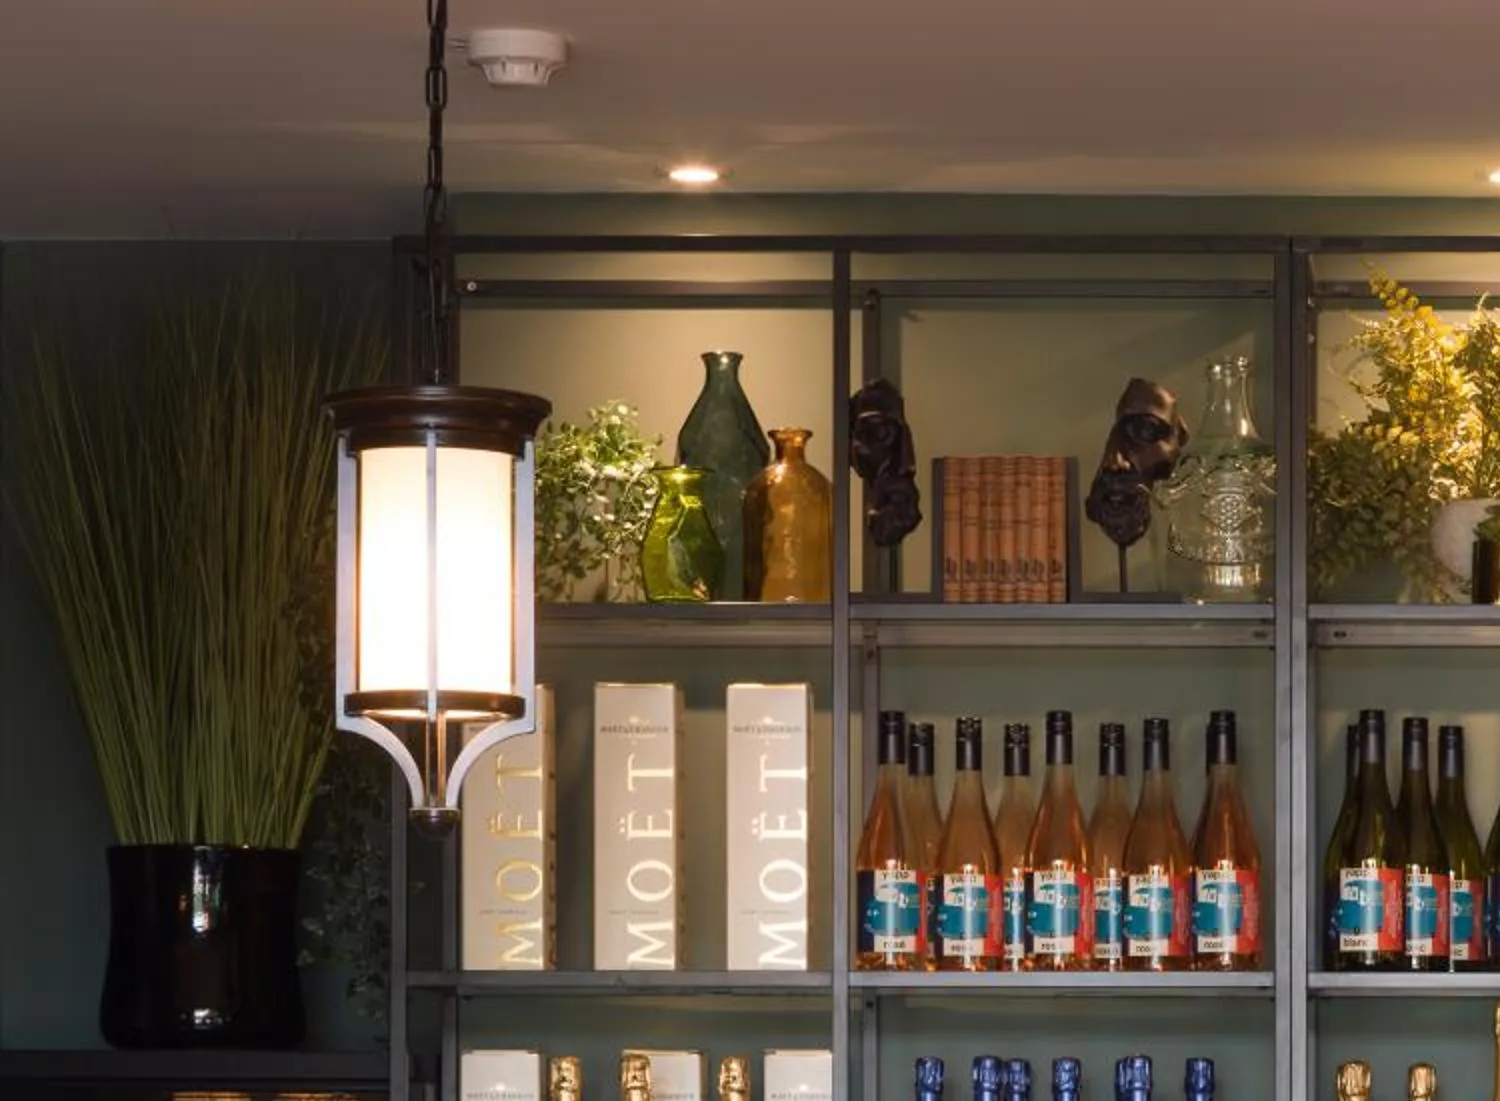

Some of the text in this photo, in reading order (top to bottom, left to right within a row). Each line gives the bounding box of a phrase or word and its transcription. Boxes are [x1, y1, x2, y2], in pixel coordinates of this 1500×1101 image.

[490, 753, 544, 967] MOËT
[618, 753, 675, 967] MOËT
[751, 753, 807, 967] MOËT
